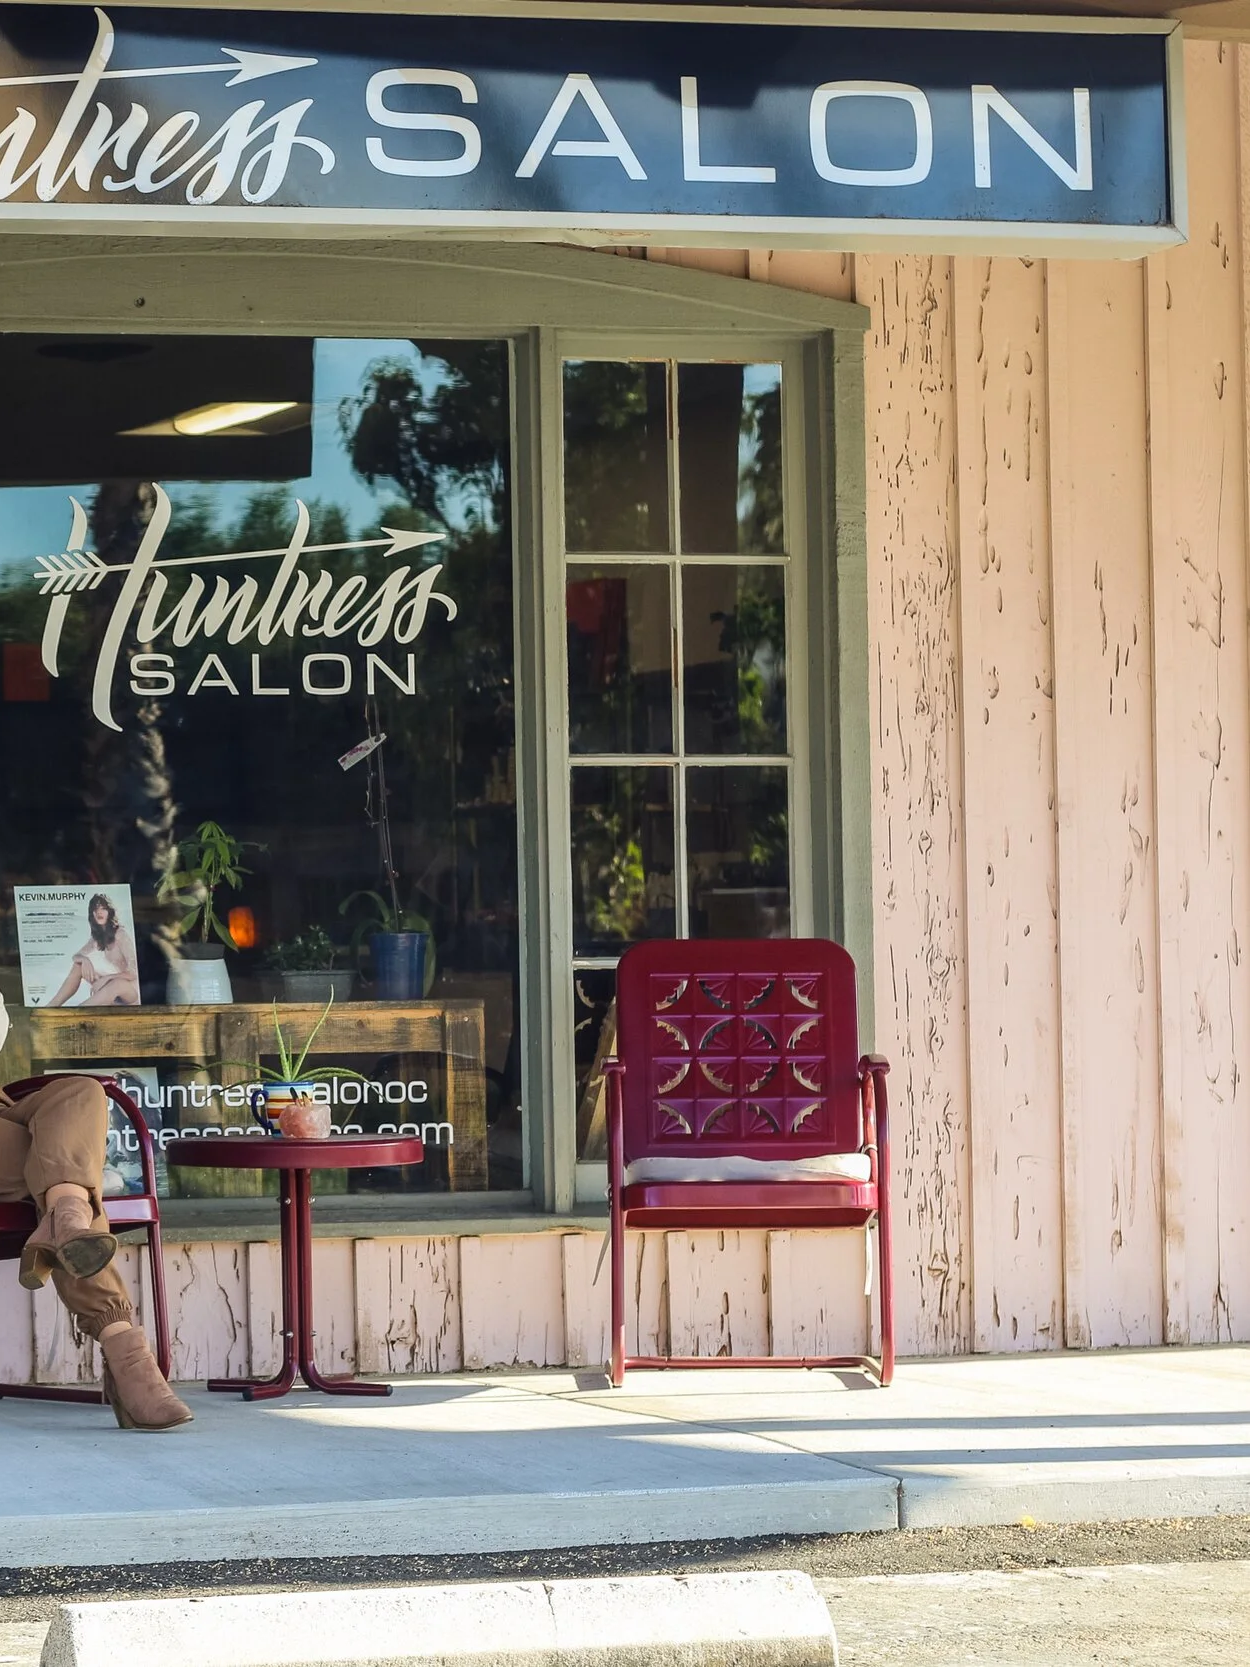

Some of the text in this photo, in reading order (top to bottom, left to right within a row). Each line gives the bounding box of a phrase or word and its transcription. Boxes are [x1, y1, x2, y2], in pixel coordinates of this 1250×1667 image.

[364, 66, 1094, 191] SALON
[34, 481, 458, 732] Huntress
[129, 653, 416, 696] SALON
[18, 892, 87, 902] KEVIN.MURPHY
